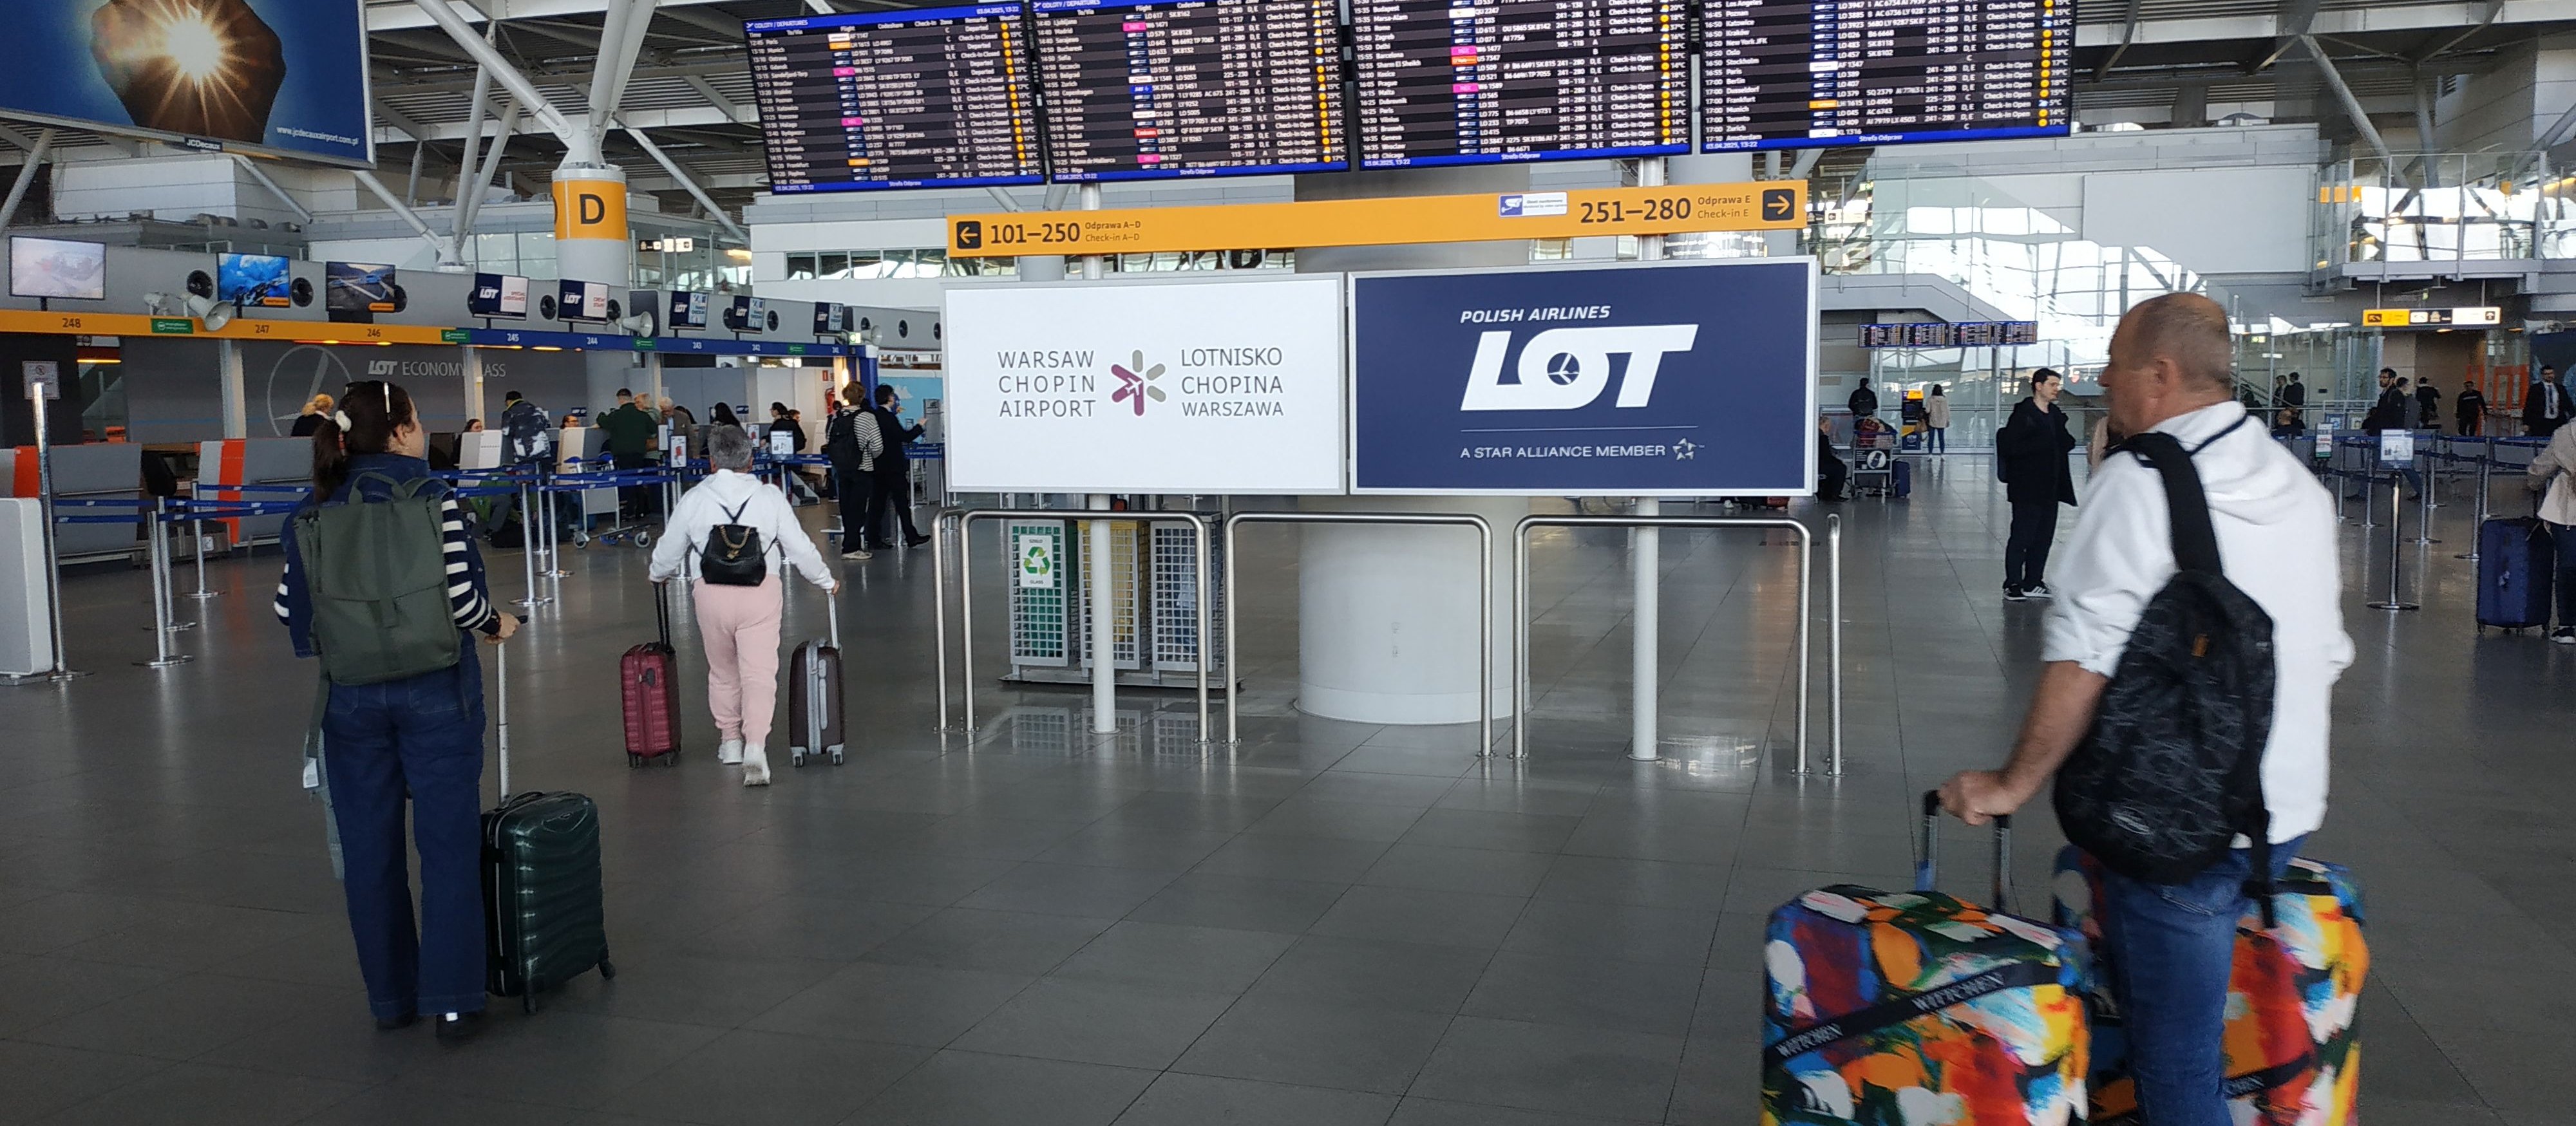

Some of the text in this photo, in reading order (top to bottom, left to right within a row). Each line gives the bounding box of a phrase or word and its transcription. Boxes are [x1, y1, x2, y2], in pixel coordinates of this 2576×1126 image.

[186, 139, 220, 150] JCDecaux
[1698, 195, 1750, 207] Odprawa E
[580, 194, 605, 224] D
[1698, 209, 1748, 220] Check-in E
[1085, 221, 1121, 232] Odprawa
[1085, 233, 1121, 242] Check-in
[479, 288, 498, 299] LOT
[564, 294, 582, 304] LOT
[674, 304, 687, 313] LOT
[1461, 306, 1611, 323] POLISH AIRLINES
[62, 318, 81, 328] 248
[256, 325, 269, 333] 247
[367, 328, 381, 337] 246
[507, 333, 519, 342] 245
[587, 337, 598, 345] 244
[692, 341, 702, 350] 243
[998, 350, 1094, 369] WARSAW
[1181, 347, 1282, 367] LOTNISKO
[368, 361, 397, 375] LOT
[484, 364, 506, 377] ASS
[1461, 324, 1699, 411] LOT
[999, 375, 1095, 393] CHOPIN
[1181, 376, 1283, 394] CHOPINA
[999, 400, 1095, 417] AIRPORT
[1182, 402, 1283, 417] WARSZAWA
[1461, 446, 1665, 459] A STAR ALLIANCE MEMBER
